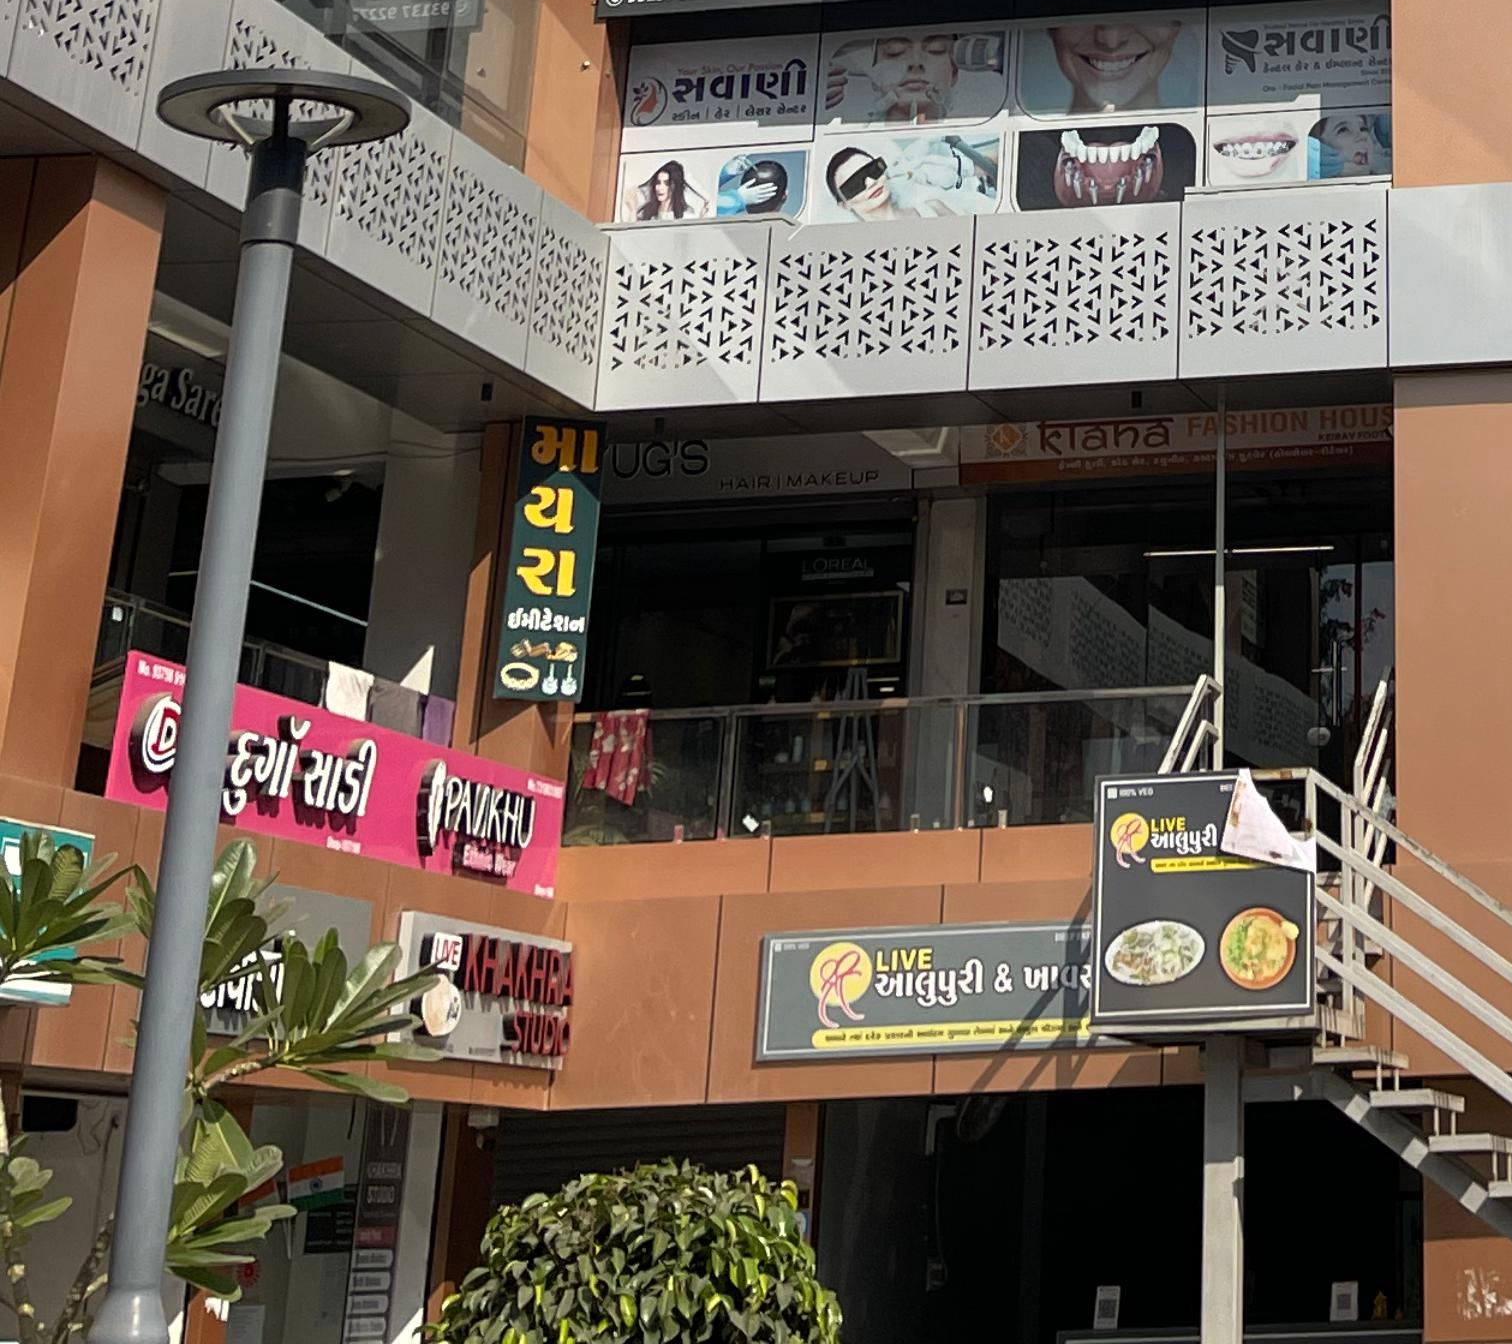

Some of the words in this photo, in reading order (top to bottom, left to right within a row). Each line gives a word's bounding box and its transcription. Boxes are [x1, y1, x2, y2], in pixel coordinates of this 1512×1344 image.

[672, 58, 807, 104] સવાણી
[1188, 410, 1308, 437] FASHION
[720, 475, 772, 491] HAIR
[786, 469, 879, 487] MAKEUP
[506, 606, 586, 634] ઈમીટેશન
[304, 739, 378, 817] સાડી
[1150, 823, 1218, 855] આલુપુરી
[1151, 816, 1186, 832] LIVE
[435, 936, 461, 966] LIVE
[874, 948, 934, 972] LIVE
[463, 933, 573, 1006] KHAKHRA
[874, 958, 985, 1008] આલુપુરી
[993, 963, 1014, 993] &
[512, 1008, 571, 1058] STUDIO
